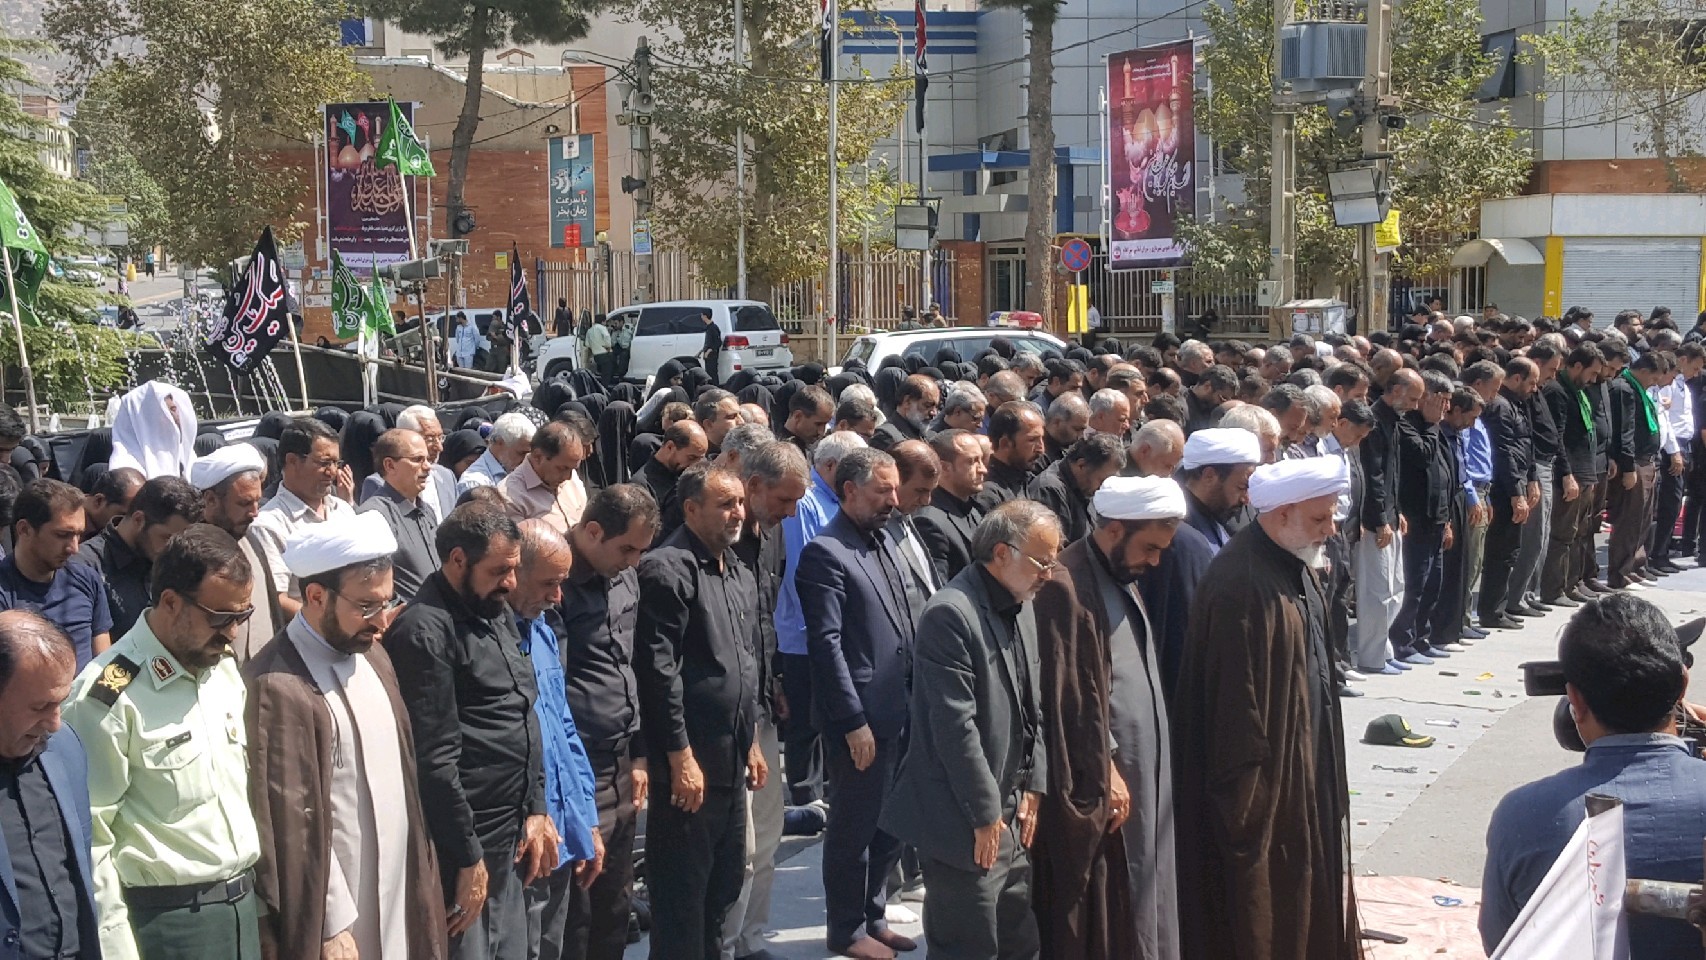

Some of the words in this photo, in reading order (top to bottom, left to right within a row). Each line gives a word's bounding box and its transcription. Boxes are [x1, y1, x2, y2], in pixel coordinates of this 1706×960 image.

[555, 197, 580, 206] سرعت
[580, 194, 588, 205] با
[556, 206, 570, 218] بخر
[570, 205, 588, 217] زمان
